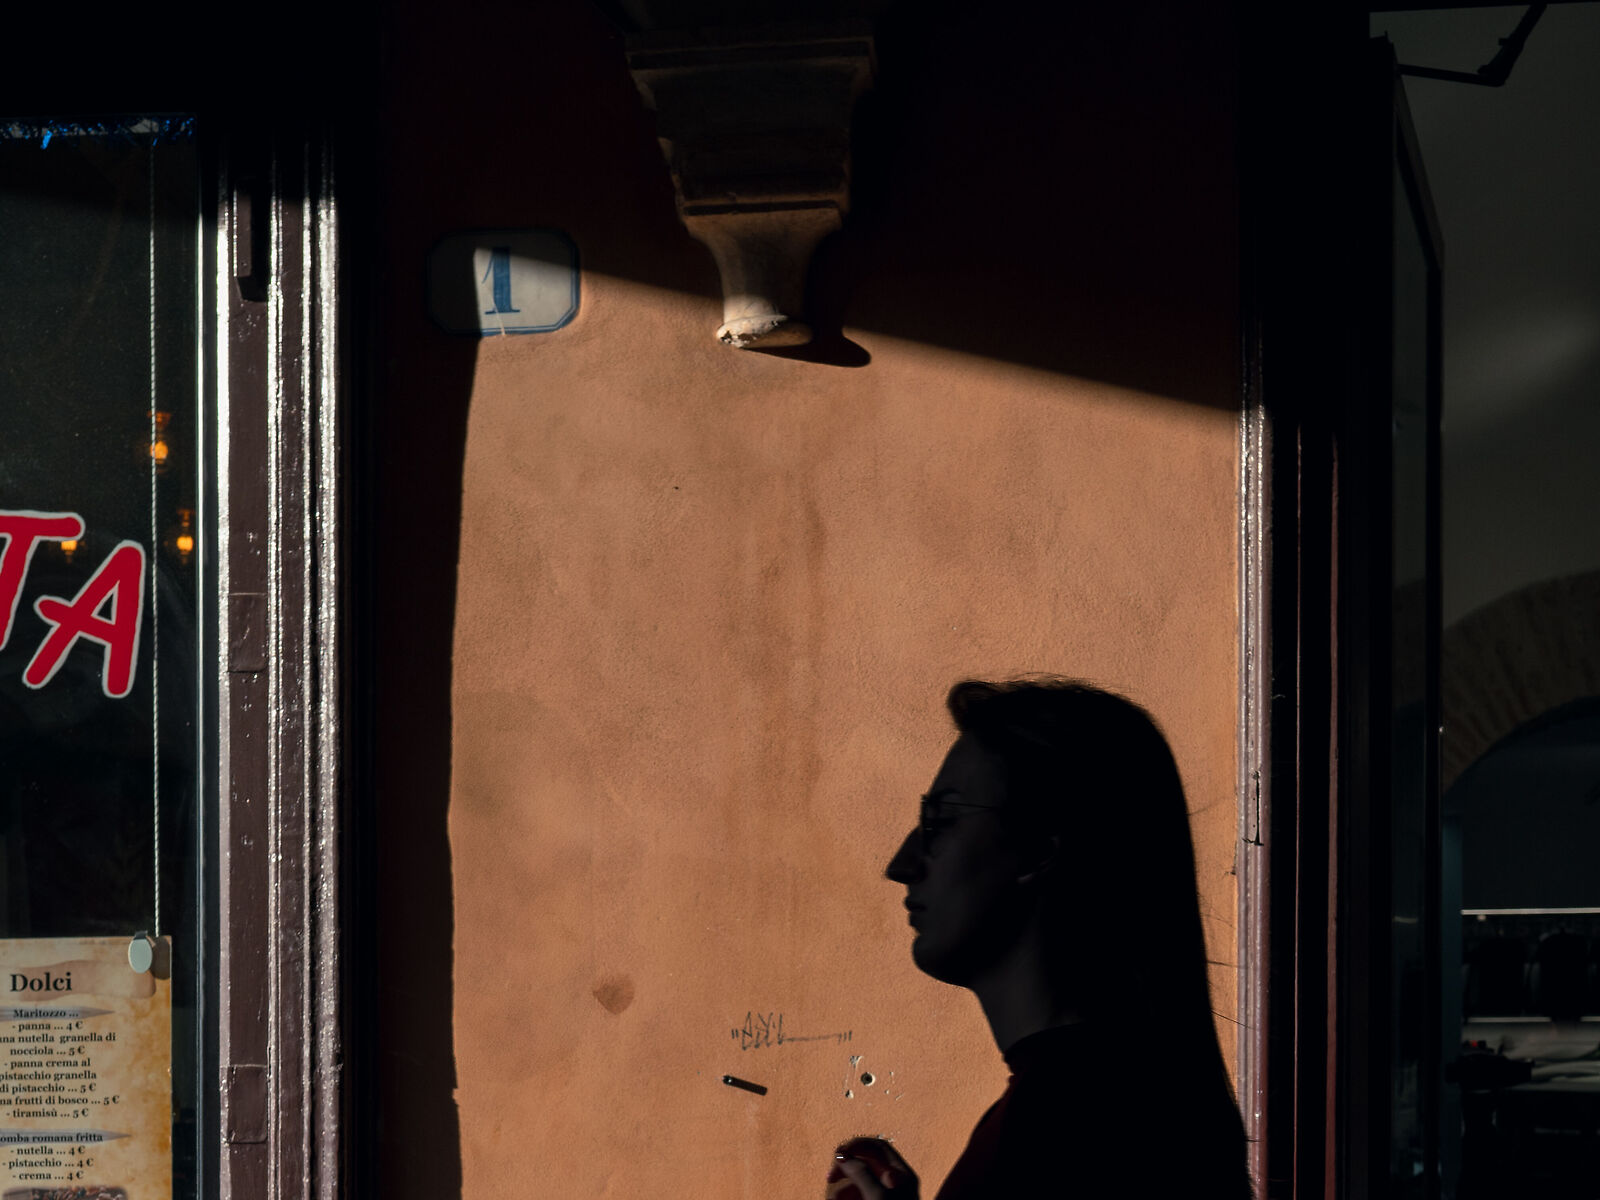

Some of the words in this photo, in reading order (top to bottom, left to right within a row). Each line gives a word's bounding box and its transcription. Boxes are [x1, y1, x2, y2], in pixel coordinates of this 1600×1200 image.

[482, 245, 520, 315] 1
[10, 972, 72, 992] Dolci
[13, 1009, 66, 1018] Maritozzo
[18, 1023, 51, 1032] panna
[66, 1022, 72, 1031] 4
[75, 1021, 83, 1030] €
[18, 1034, 54, 1043] nutella
[60, 1032, 103, 1044] granella
[105, 1032, 116, 1041] di
[10, 1046, 53, 1056] nocciola
[68, 1047, 75, 1056] 5
[78, 1045, 85, 1055] €
[10, 1061, 43, 1070] panna
[45, 1060, 78, 1068] crema
[81, 1058, 91, 1067] al
[53, 1070, 96, 1081] granella
[0, 1084, 9, 1093] di
[12, 1083, 65, 1095] pistacchio
[80, 1085, 86, 1094] 5
[89, 1083, 97, 1092] €
[15, 1096, 42, 1105] frutti
[45, 1096, 56, 1105] di
[58, 1095, 88, 1105] bosco
[103, 1097, 110, 1106] 5
[112, 1095, 120, 1104] €
[13, 1108, 57, 1118] tiramisù
[72, 1110, 79, 1119] 5
[81, 1108, 89, 1117] €
[32, 1134, 73, 1142] romana
[76, 1132, 103, 1142] fritta
[17, 1146, 54, 1155] nutella
[68, 1147, 75, 1156] 4
[77, 1146, 85, 1154] €
[8, 1158, 62, 1170] pistacchio
[76, 1160, 83, 1168] 4
[86, 1158, 94, 1167] €
[19, 1172, 52, 1180] crema
[67, 1172, 73, 1181] 4
[76, 1171, 84, 1179] €
